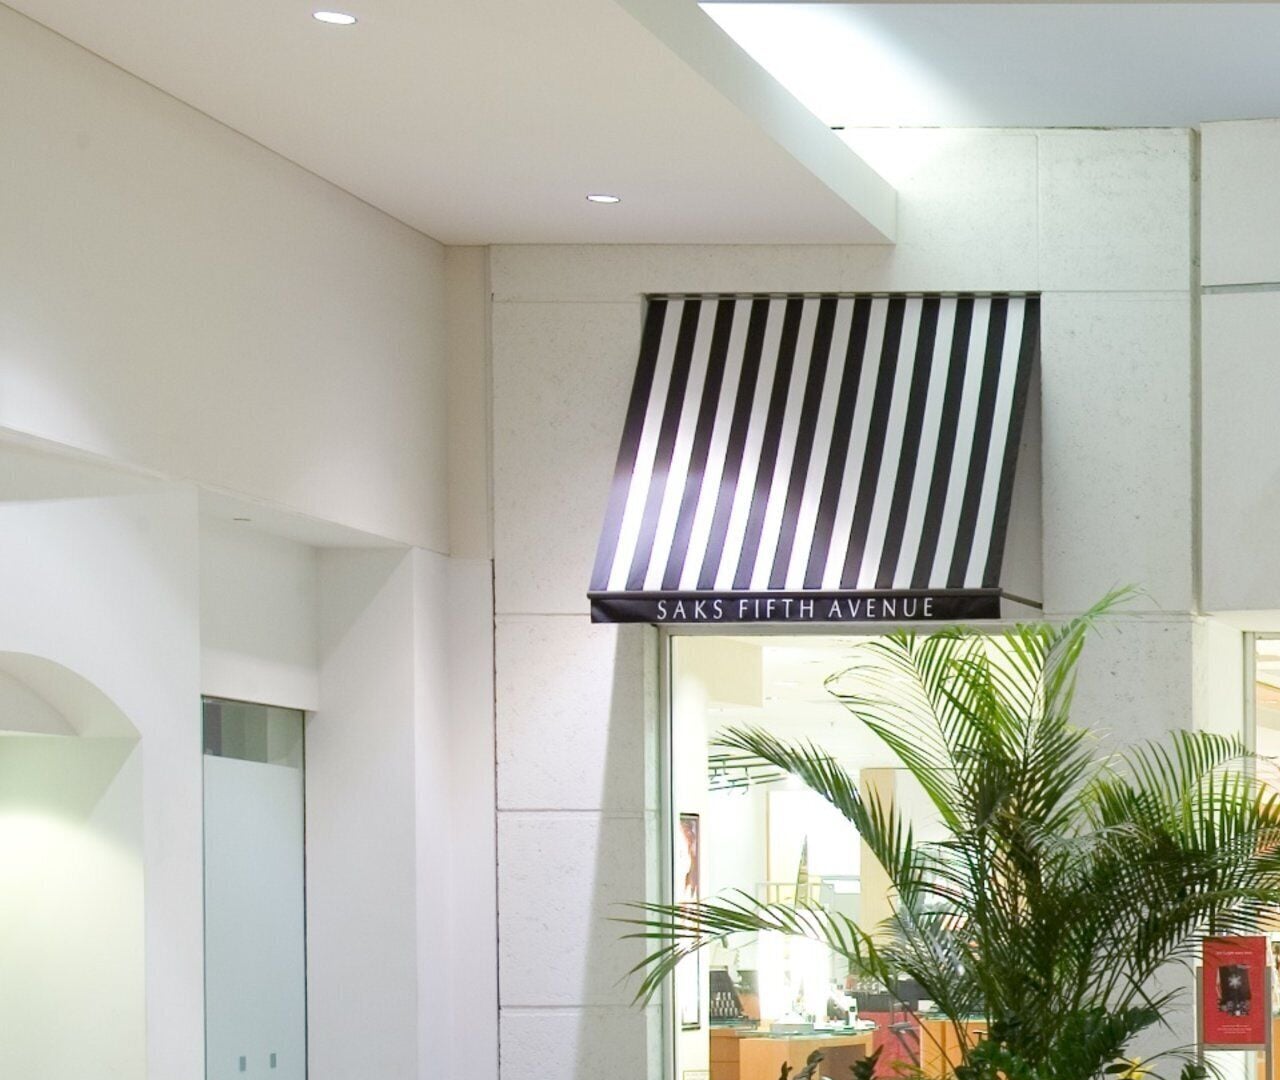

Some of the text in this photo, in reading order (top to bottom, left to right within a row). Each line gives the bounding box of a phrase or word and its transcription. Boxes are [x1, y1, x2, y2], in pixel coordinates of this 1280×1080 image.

[656, 597, 933, 620] SAKS FIFTH AVENUE
